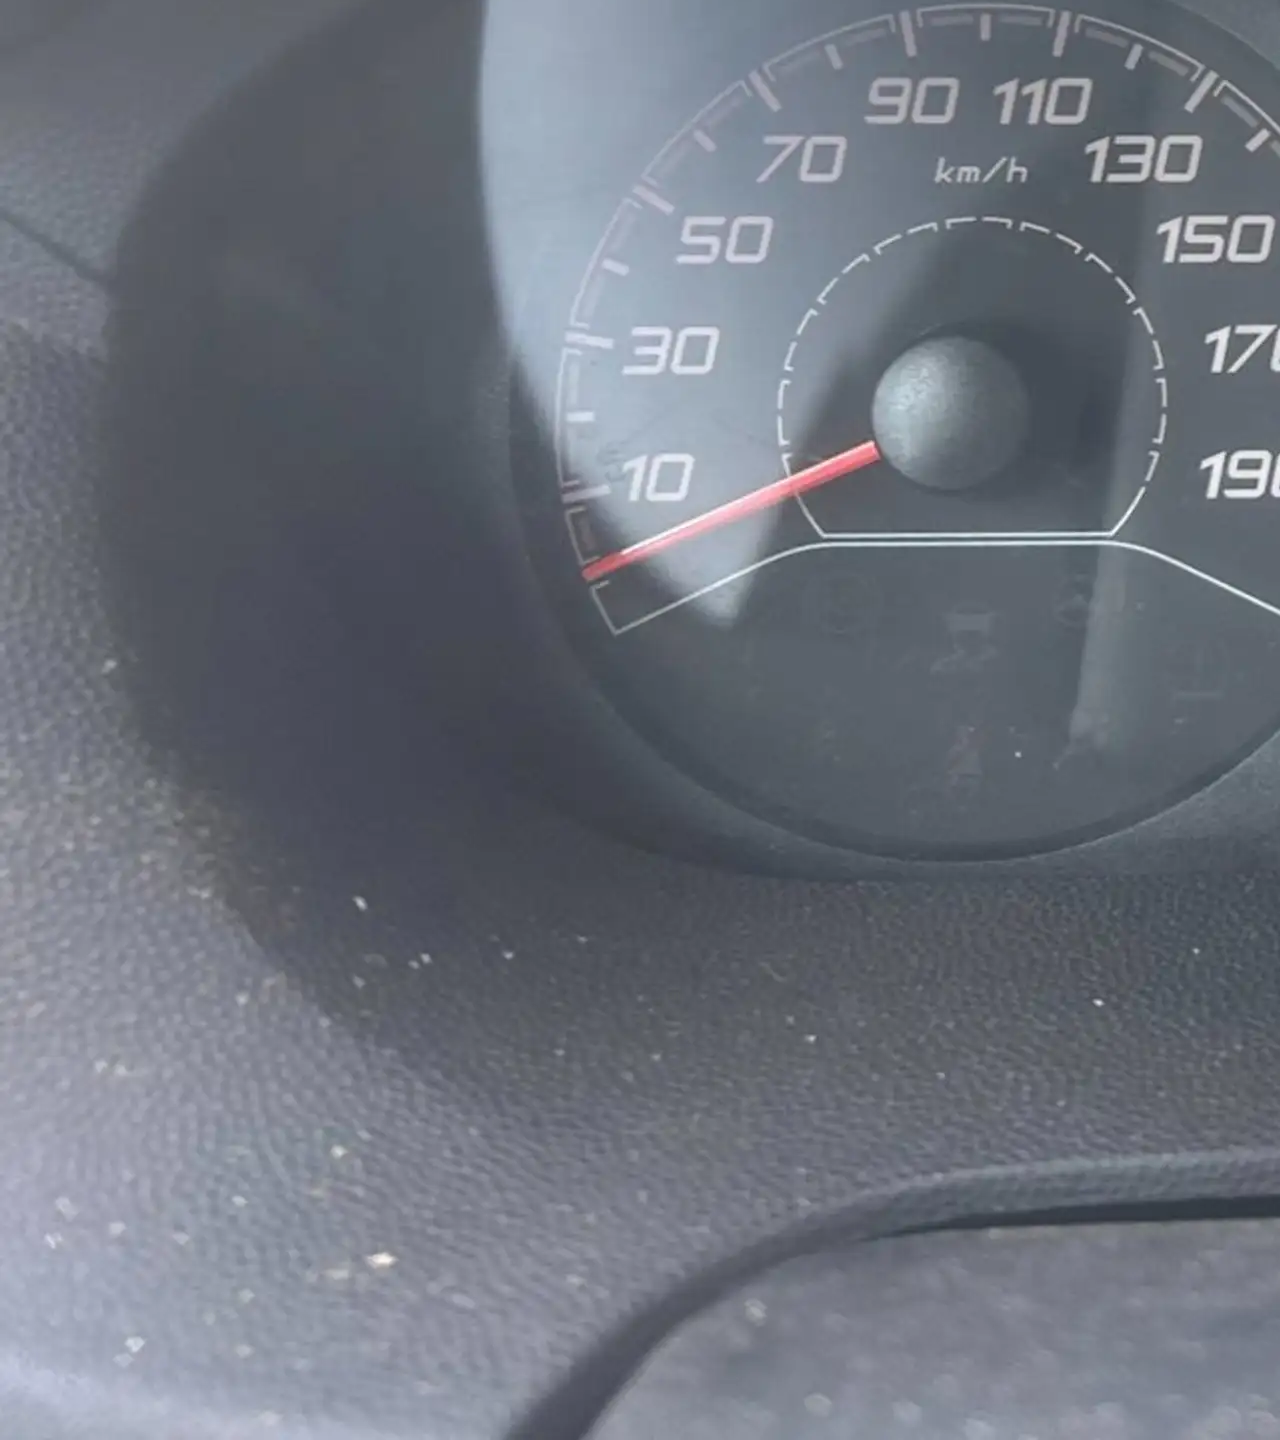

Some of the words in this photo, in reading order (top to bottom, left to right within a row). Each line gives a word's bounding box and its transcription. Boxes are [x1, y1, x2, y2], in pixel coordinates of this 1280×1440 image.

[863, 77, 959, 125] 90
[993, 77, 1093, 126] 110
[755, 135, 847, 184] 70
[933, 156, 1028, 184] km/h
[1085, 134, 1203, 183] 130
[674, 215, 773, 265] 50
[1156, 215, 1276, 264] 150
[621, 326, 720, 376] 30
[622, 453, 696, 502] 10
